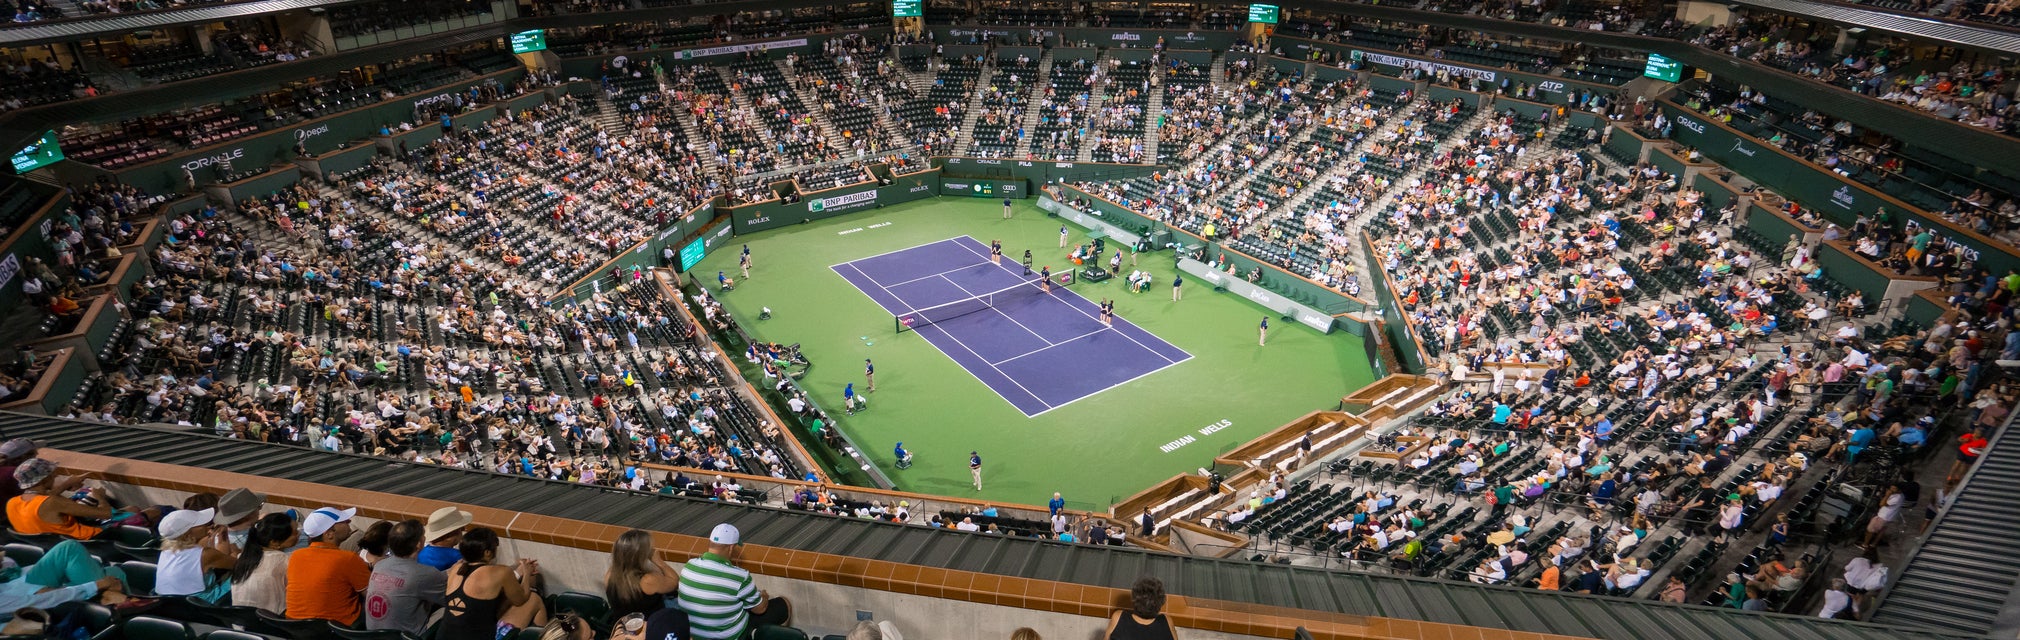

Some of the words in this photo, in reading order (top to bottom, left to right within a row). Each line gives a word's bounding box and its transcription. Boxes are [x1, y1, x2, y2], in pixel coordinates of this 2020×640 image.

[1540, 80, 1564, 90] ATP
[306, 124, 329, 139] pepsi
[1677, 115, 1705, 134] ORACLE
[186, 149, 244, 171] ORACLE
[910, 185, 929, 193] ROLEX
[825, 198, 841, 207] BNP
[843, 191, 875, 203] PARIBAS
[748, 216, 770, 225] ROLEX
[867, 221, 893, 229] WELLS
[0, 256, 18, 286] IBAS
[1159, 434, 1197, 453] INDIAN
[1198, 418, 1233, 436] WELLS
